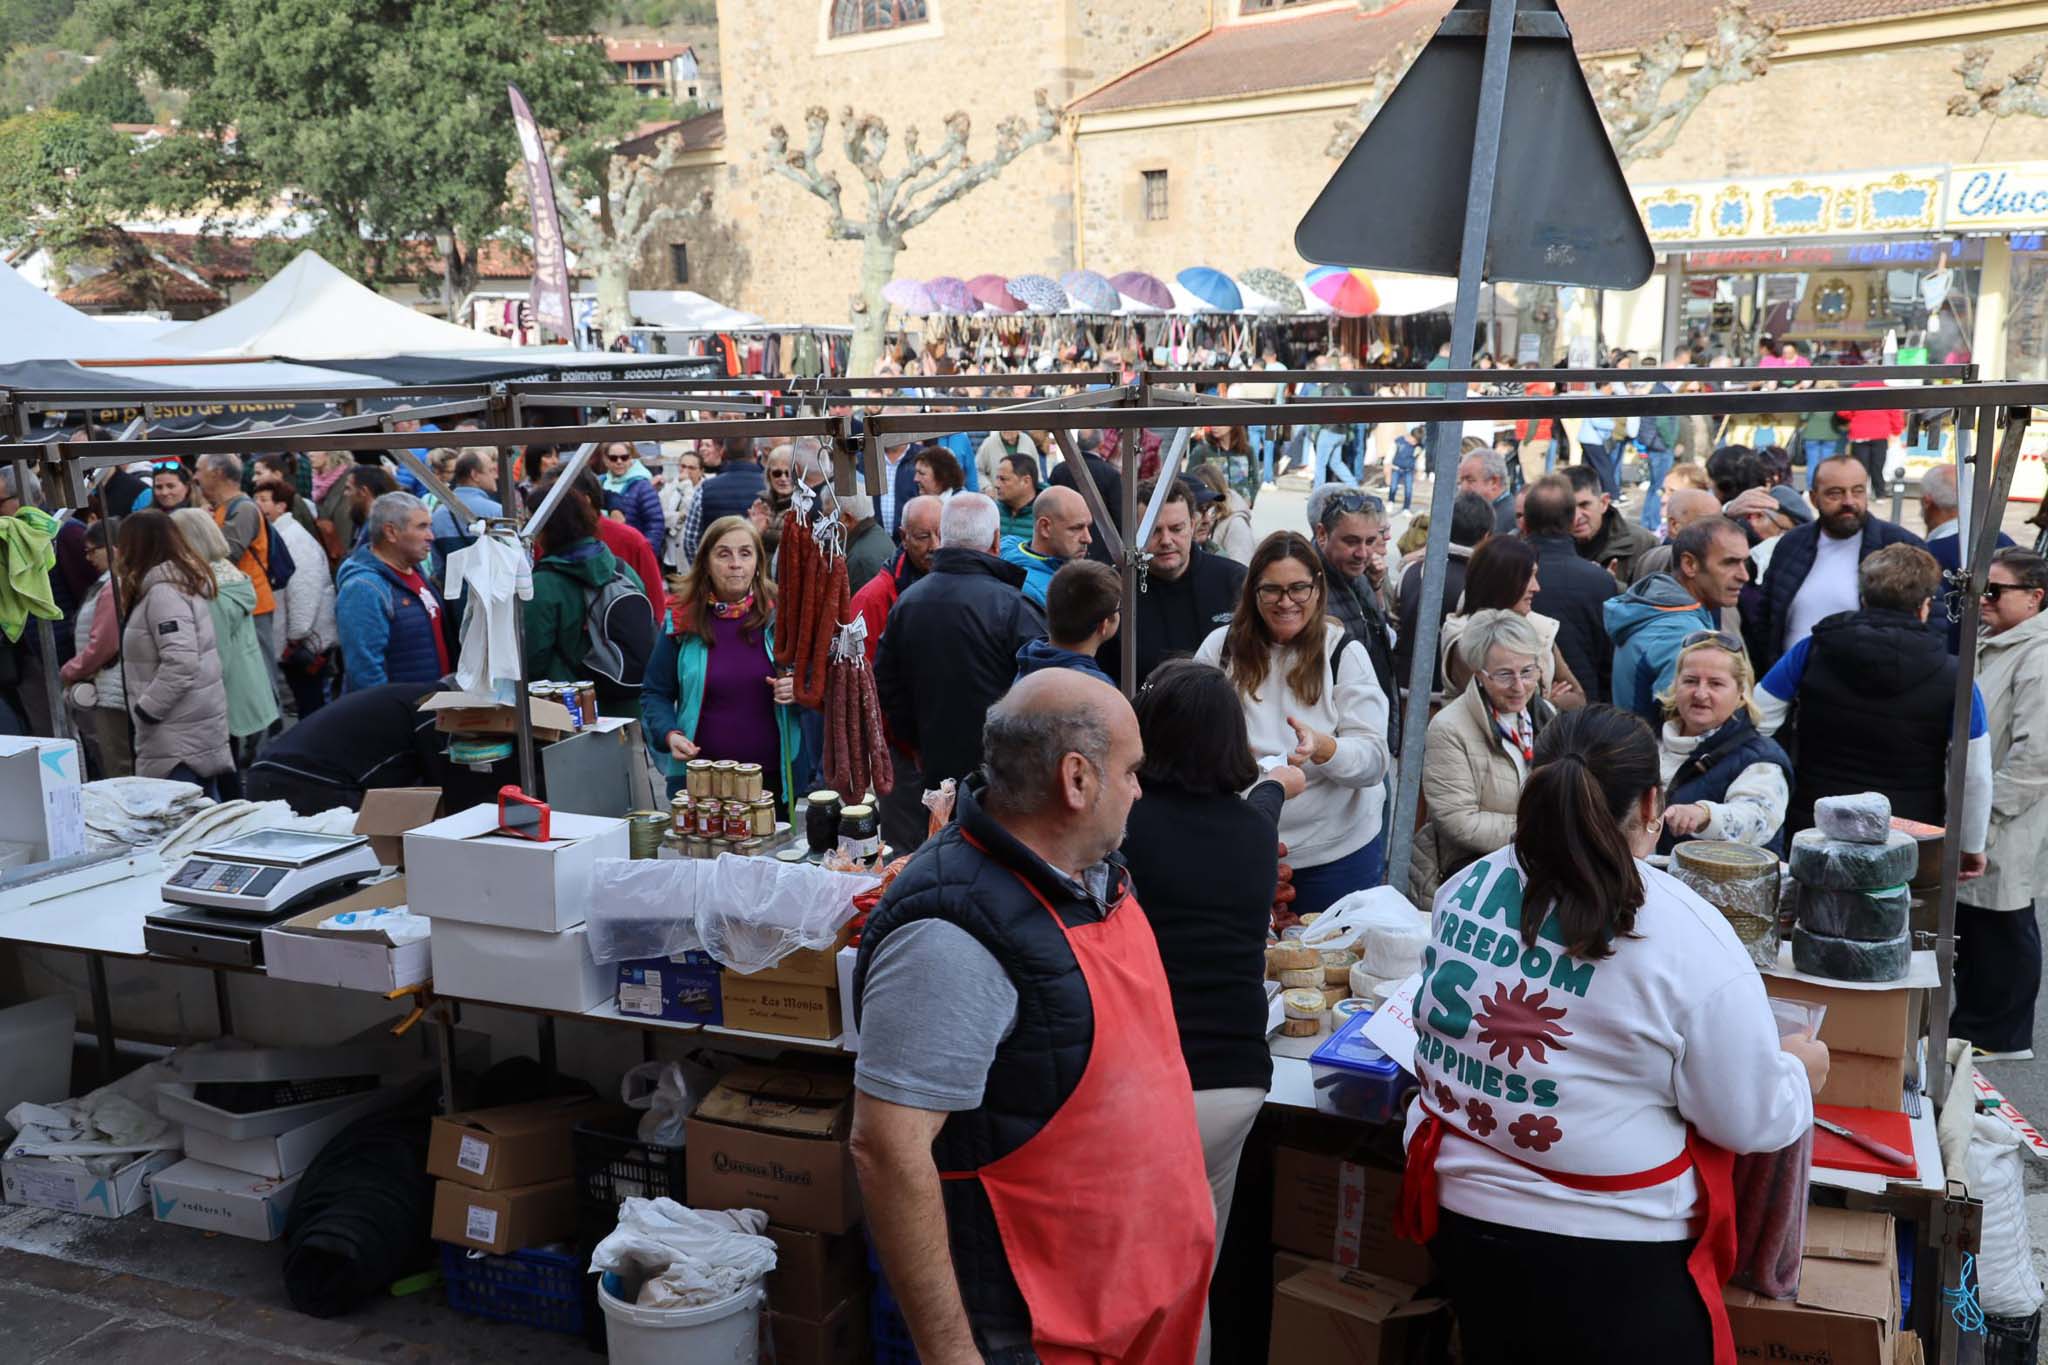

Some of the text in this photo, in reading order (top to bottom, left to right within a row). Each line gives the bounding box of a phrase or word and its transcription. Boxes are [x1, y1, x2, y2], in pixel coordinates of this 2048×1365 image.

[1958, 172, 2048, 216] Choc
[1441, 910, 1595, 998] REEDOM
[1416, 1028, 1559, 1107] APPINESS
